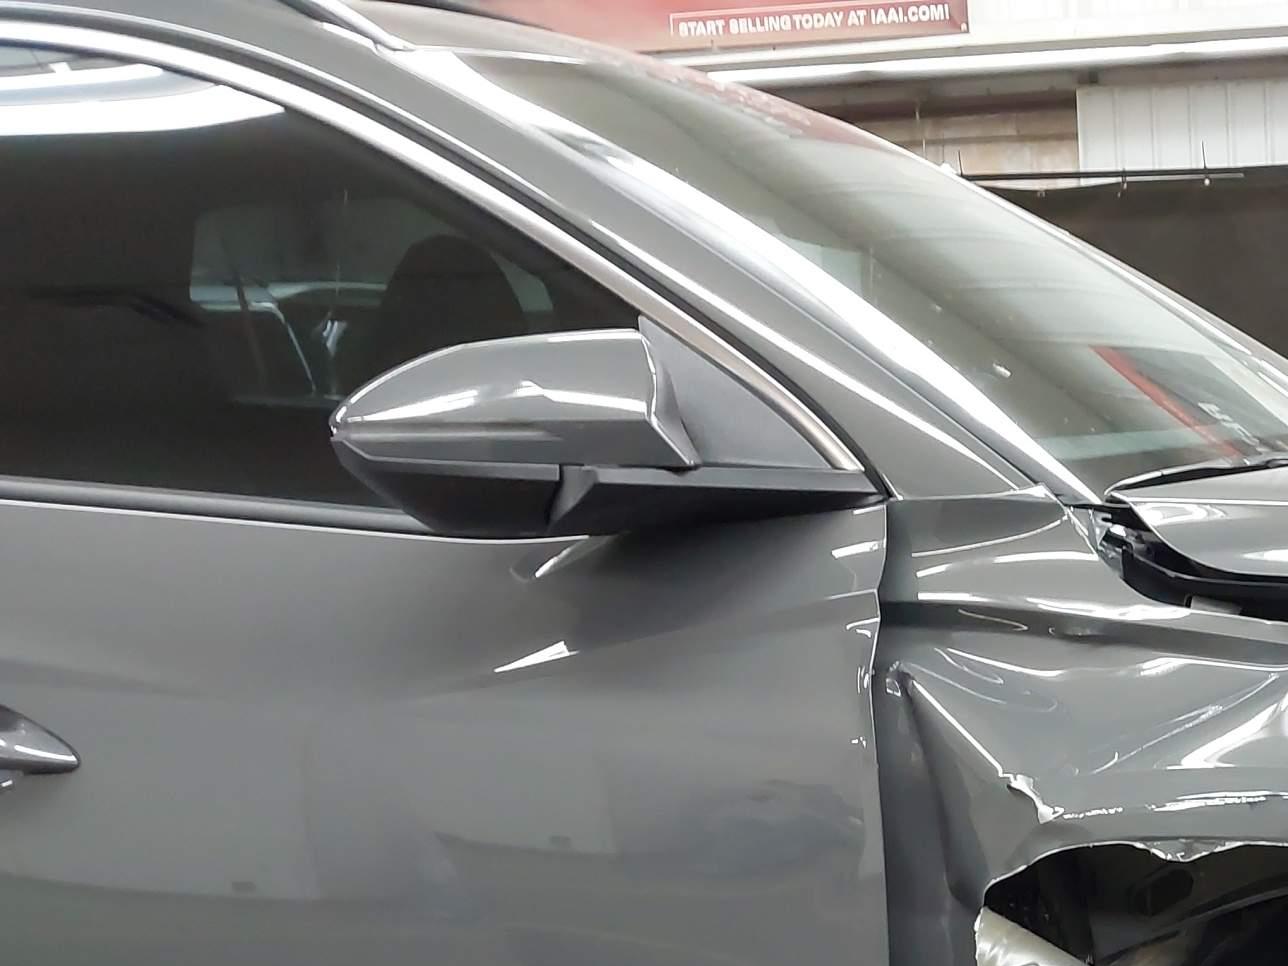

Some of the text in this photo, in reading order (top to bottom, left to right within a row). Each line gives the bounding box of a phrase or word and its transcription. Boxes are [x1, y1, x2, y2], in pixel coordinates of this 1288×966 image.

[678, 19, 725, 37] START
[729, 14, 791, 35] SELLING
[793, 11, 843, 31] TODAY
[847, 9, 867, 26] AT
